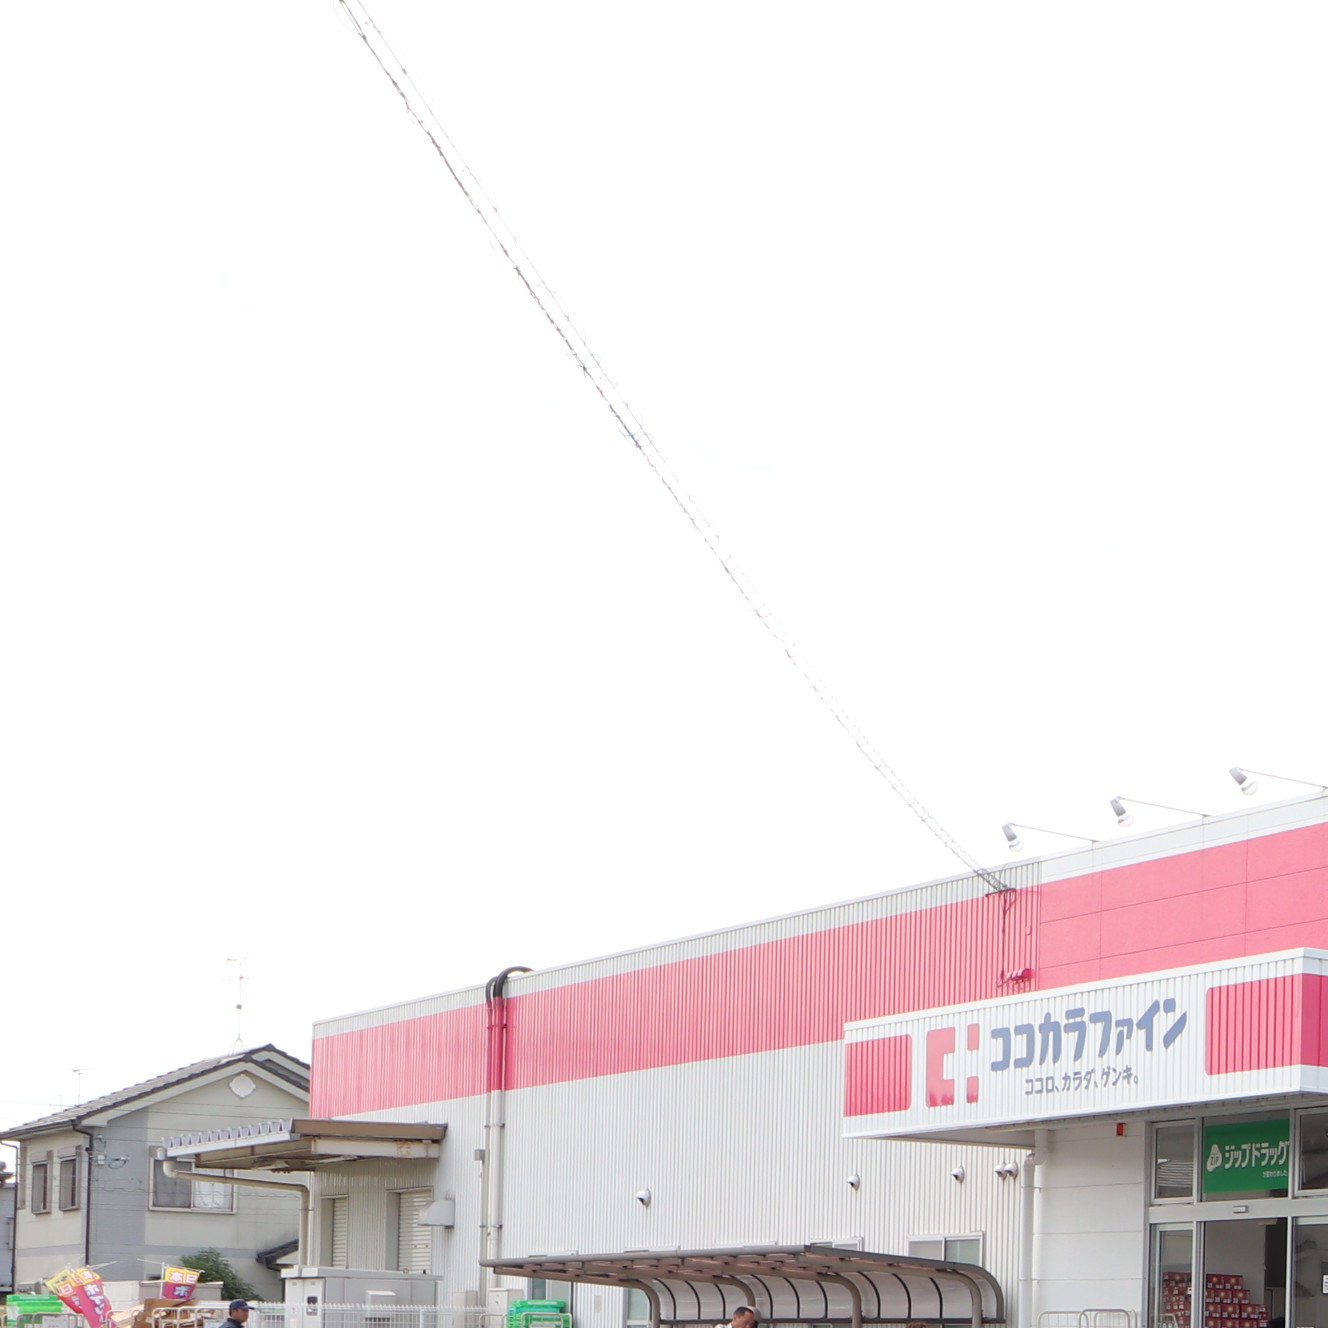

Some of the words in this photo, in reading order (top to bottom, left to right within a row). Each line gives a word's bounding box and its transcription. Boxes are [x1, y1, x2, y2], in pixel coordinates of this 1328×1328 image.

[990, 998, 1187, 1072] ココカラファイン
[1025, 1064, 1138, 1095] ココロ、カラダ、ゲンキ。
